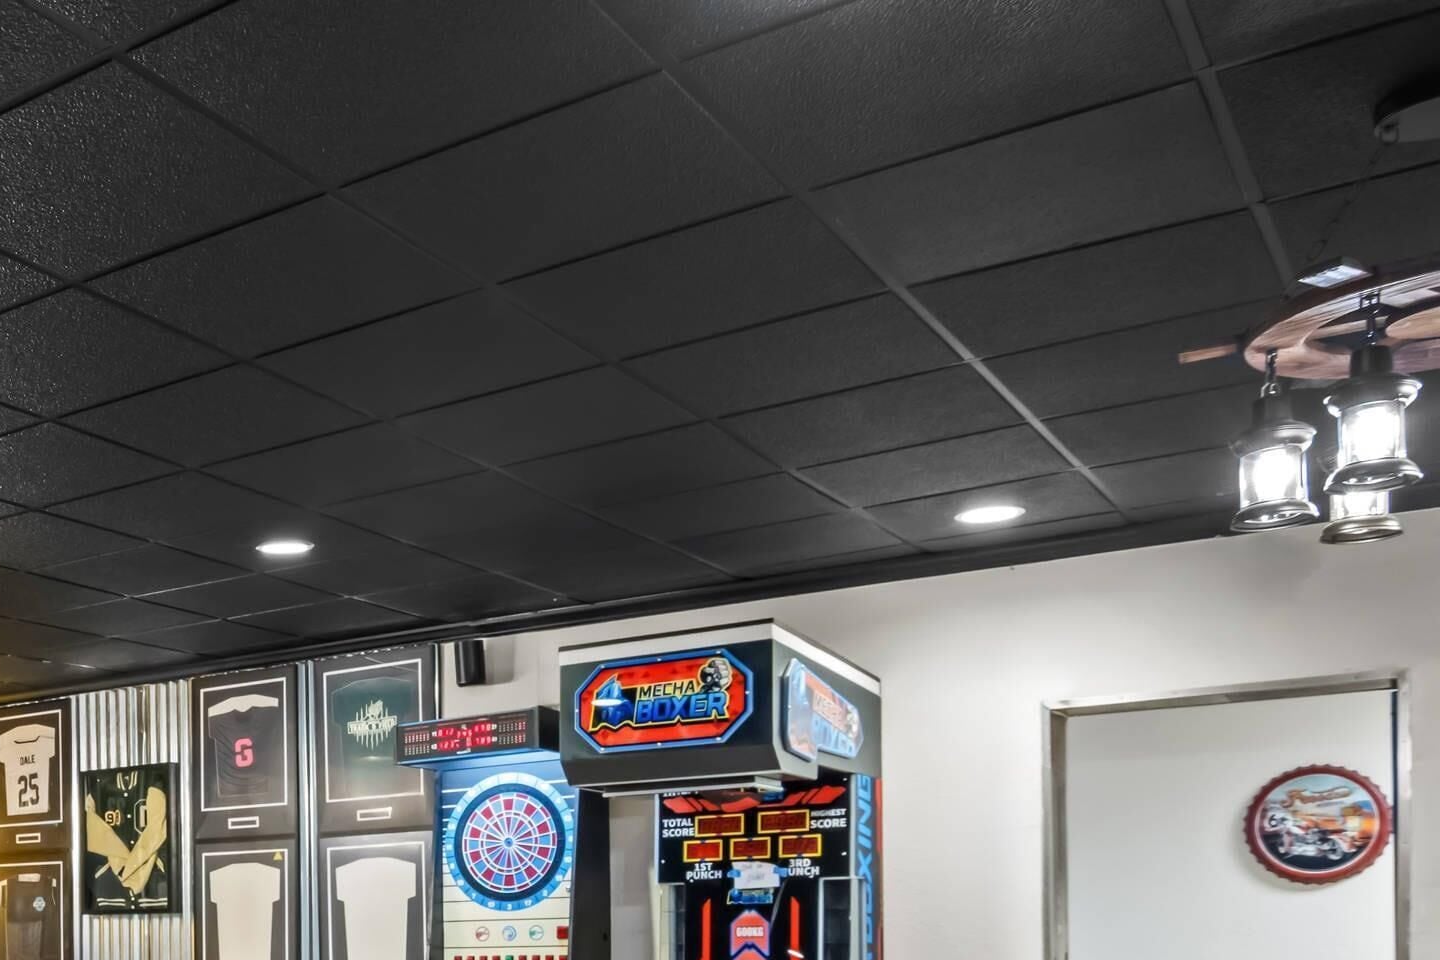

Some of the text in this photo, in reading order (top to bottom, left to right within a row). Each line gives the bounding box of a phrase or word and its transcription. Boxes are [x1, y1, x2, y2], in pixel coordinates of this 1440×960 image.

[640, 680, 695, 698] MECHA
[635, 692, 727, 723] BOXER
[20, 754, 35, 766] DALE
[18, 773, 40, 807] 25
[811, 808, 847, 817] HIGHEST
[662, 818, 693, 828] TOTAL
[810, 818, 847, 829] SCORE
[662, 827, 695, 838] SCORE
[694, 862, 713, 872] 1ST
[789, 858, 811, 868] 3RD
[686, 870, 722, 880] PUNCH
[787, 866, 820, 877] UNCH
